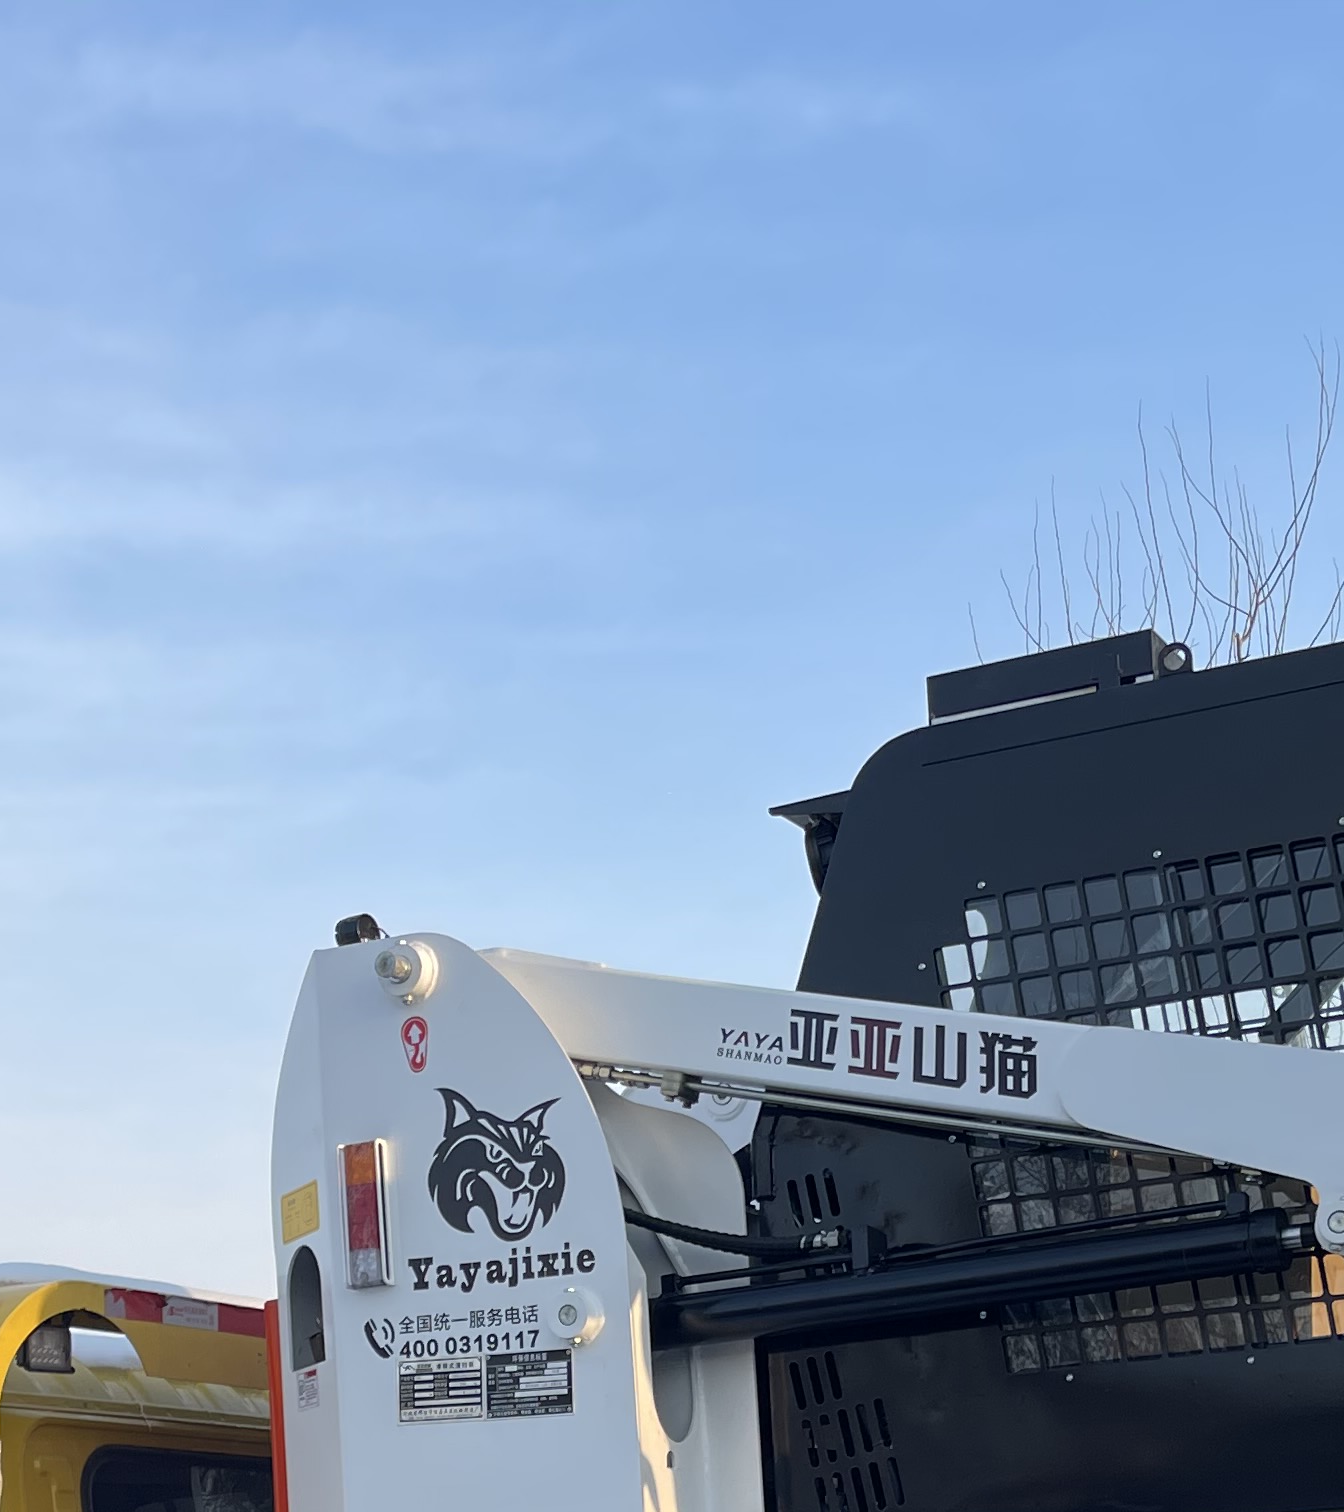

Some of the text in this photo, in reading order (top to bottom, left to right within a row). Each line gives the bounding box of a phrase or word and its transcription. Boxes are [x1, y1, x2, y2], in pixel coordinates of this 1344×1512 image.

[720, 1027, 784, 1051] YAYA
[786, 1008, 1039, 1099] 亚亚山猫
[717, 1047, 783, 1066] SHANMAO
[408, 1242, 596, 1293] Yayajixie
[398, 1304, 539, 1335] 全国统一服务电话
[399, 1329, 540, 1358] 400 0319117
